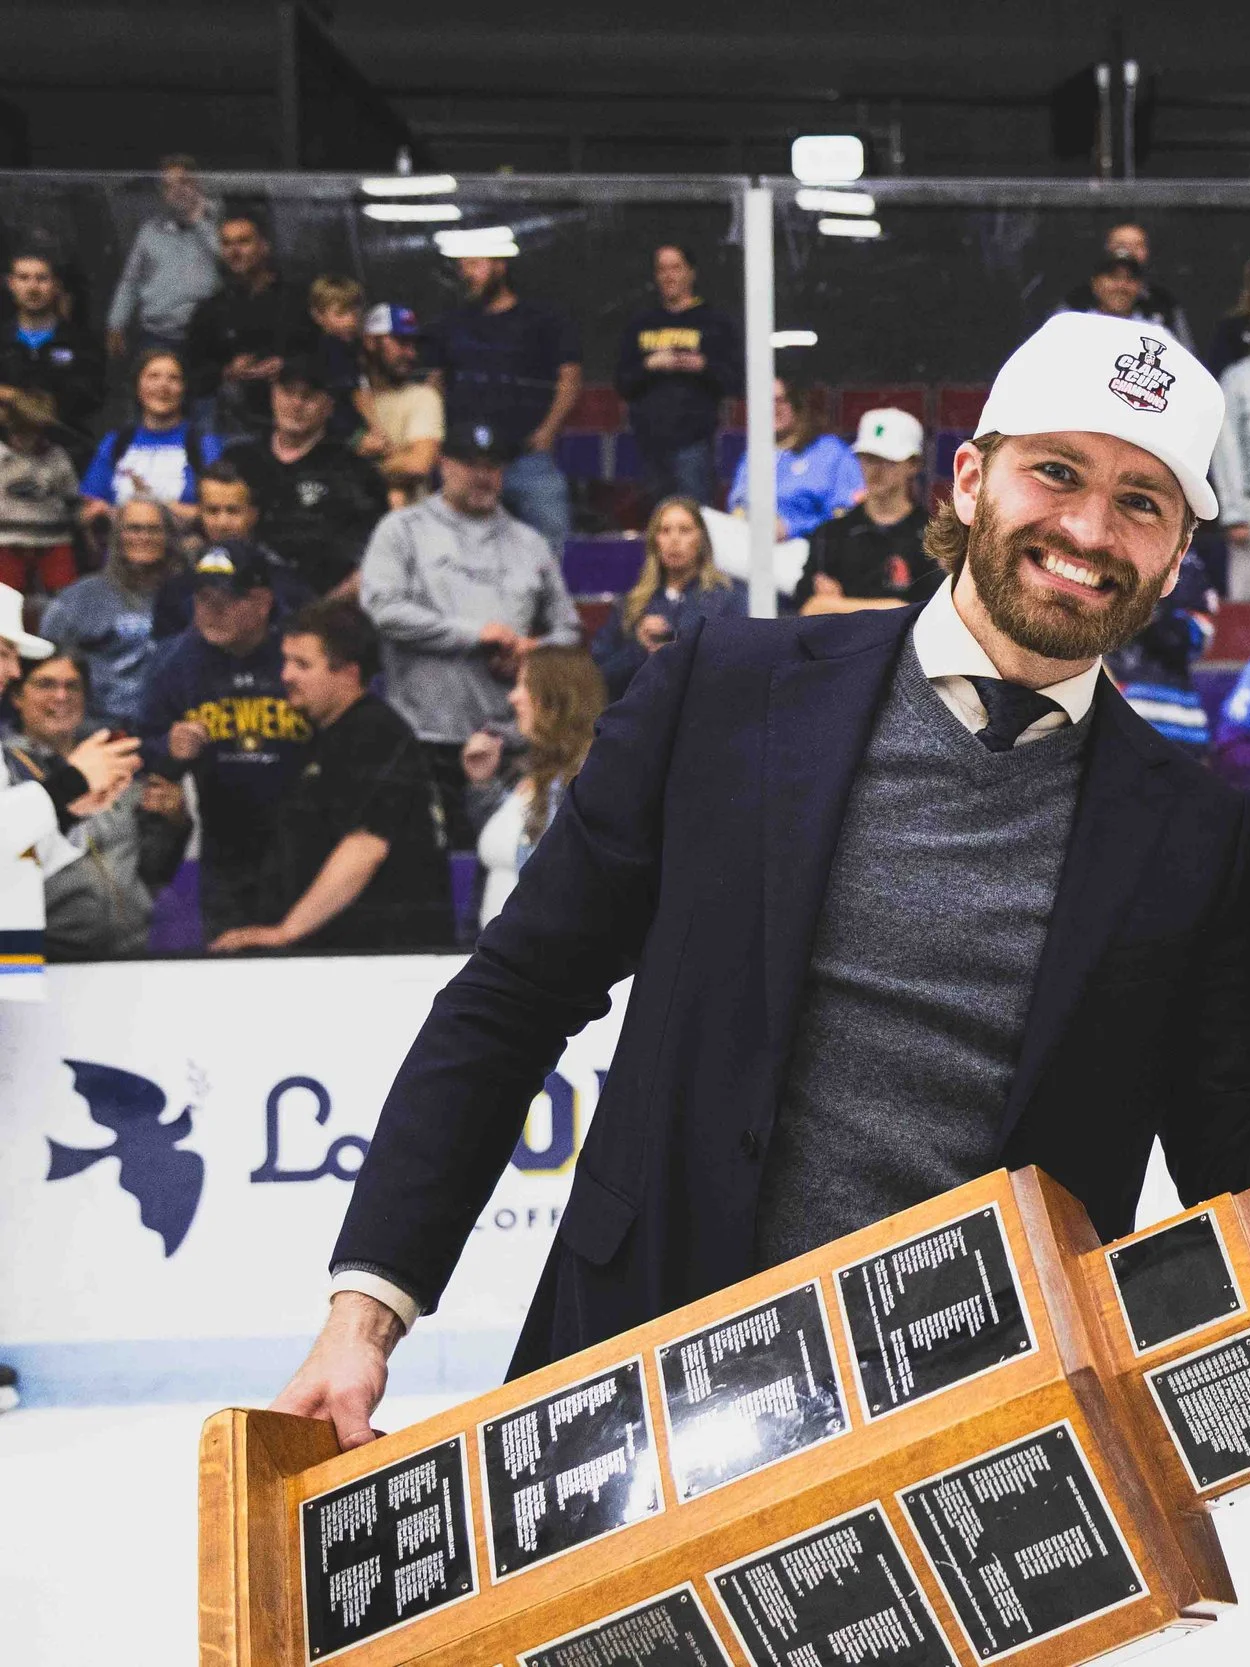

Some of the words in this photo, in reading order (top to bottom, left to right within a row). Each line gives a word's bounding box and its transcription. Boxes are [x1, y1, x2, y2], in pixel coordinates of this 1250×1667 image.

[1118, 354, 1173, 388] CLARK
[1124, 369, 1160, 391] CUP
[1110, 377, 1167, 410] CHAMPIONS
